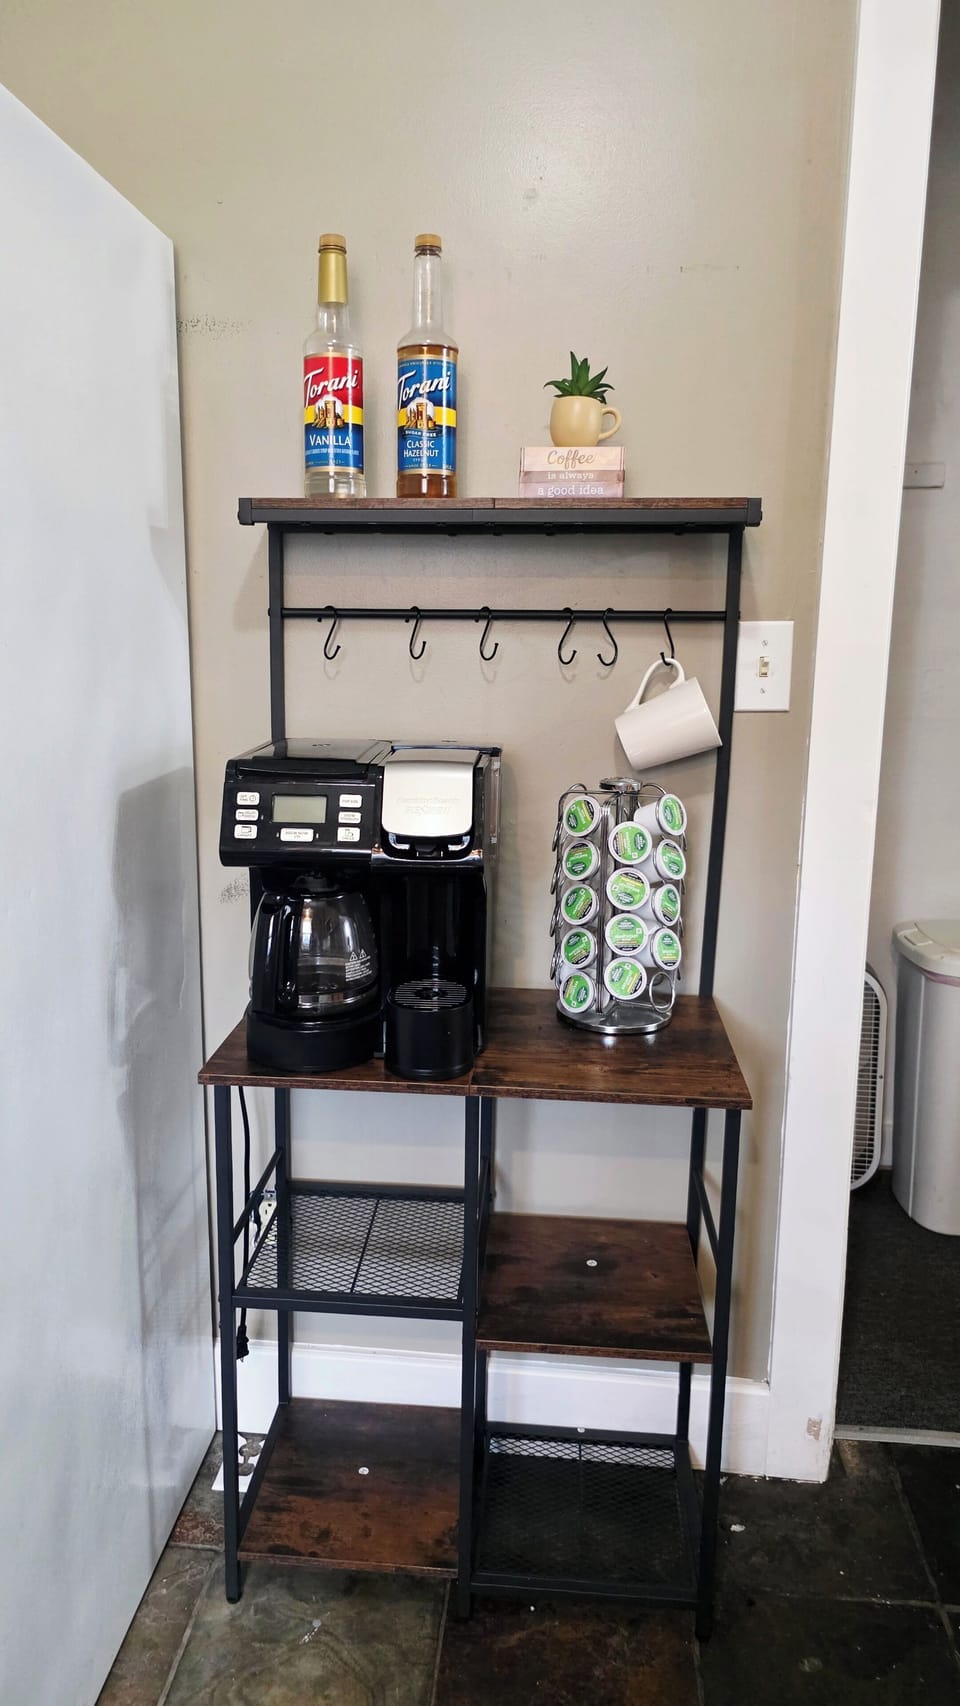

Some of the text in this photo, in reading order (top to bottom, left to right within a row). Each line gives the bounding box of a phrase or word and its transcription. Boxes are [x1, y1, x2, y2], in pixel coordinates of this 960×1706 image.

[304, 367, 358, 408] Torani
[397, 369, 451, 410] Torani
[309, 433, 351, 447] VANILLA
[406, 439, 435, 448] CLASSIC
[403, 449, 439, 458] HAZELNUT
[547, 449, 595, 470] Coffee
[547, 471, 594, 482] is always
[537, 485, 604, 497] a good idea
